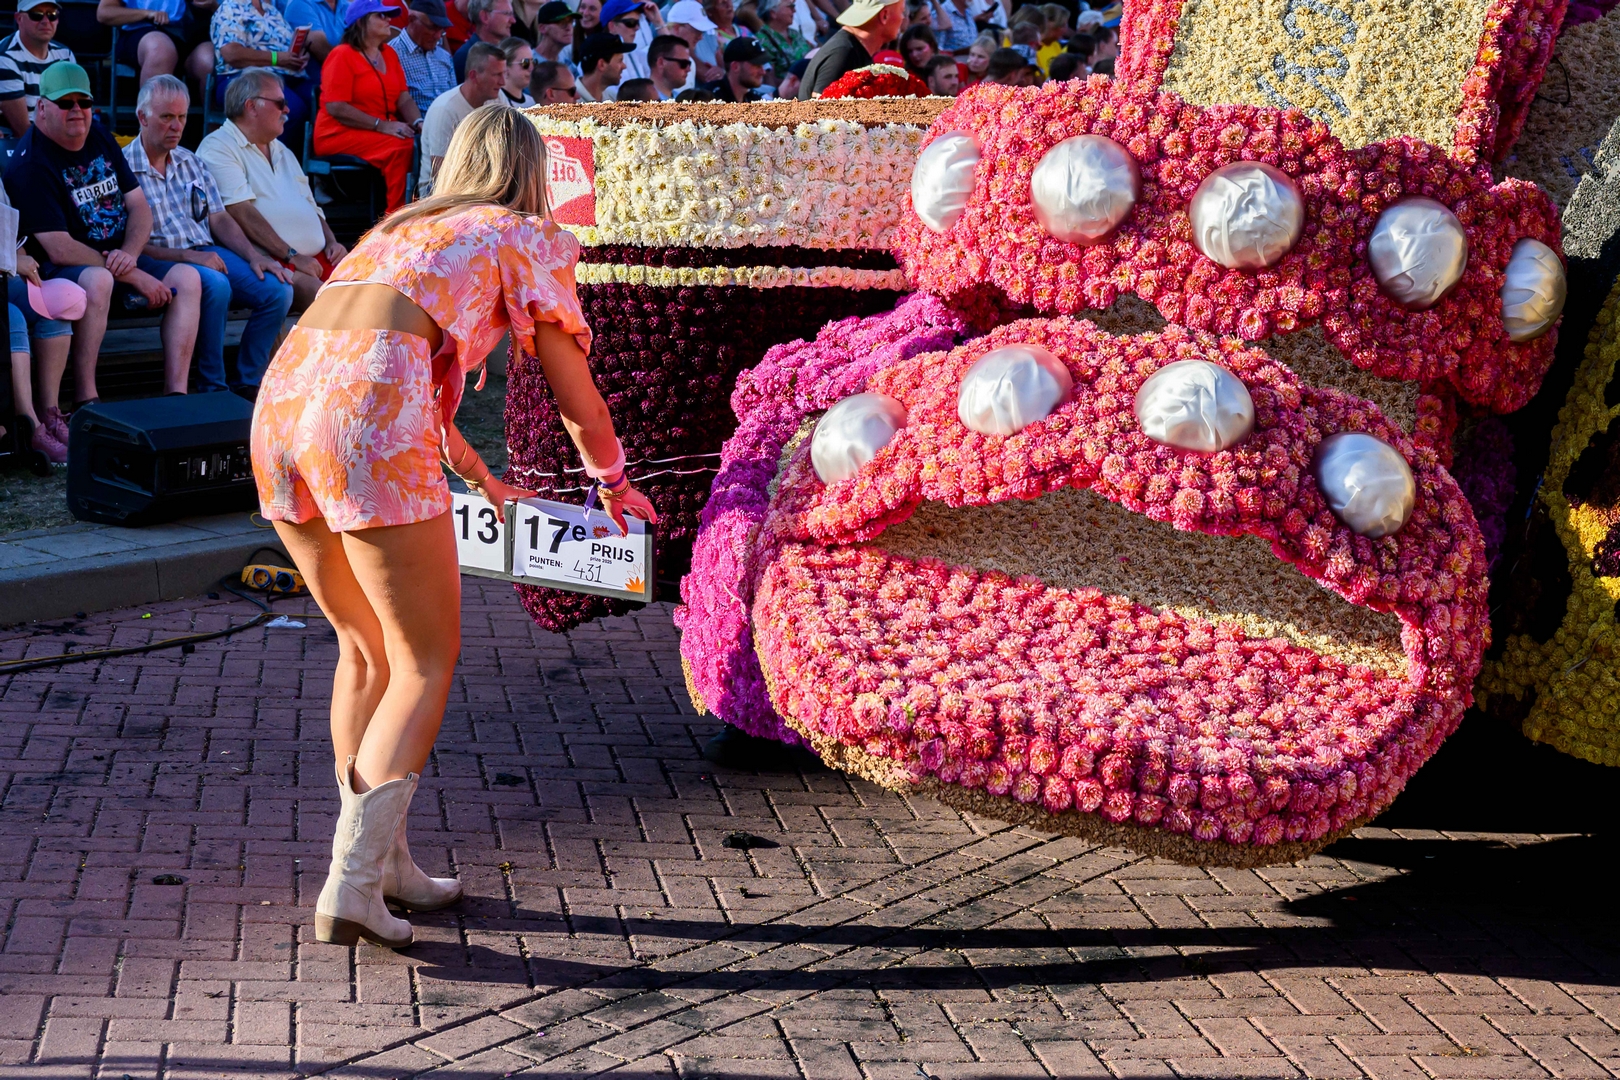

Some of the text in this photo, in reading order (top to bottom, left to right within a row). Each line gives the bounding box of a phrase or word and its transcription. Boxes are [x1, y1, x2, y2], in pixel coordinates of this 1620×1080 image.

[76, 177, 118, 202] FLORIDA
[455, 504, 499, 545] 13
[529, 555, 563, 568] PUNTEN:
[591, 542, 635, 563] PRIJS
[573, 559, 602, 583] 431
